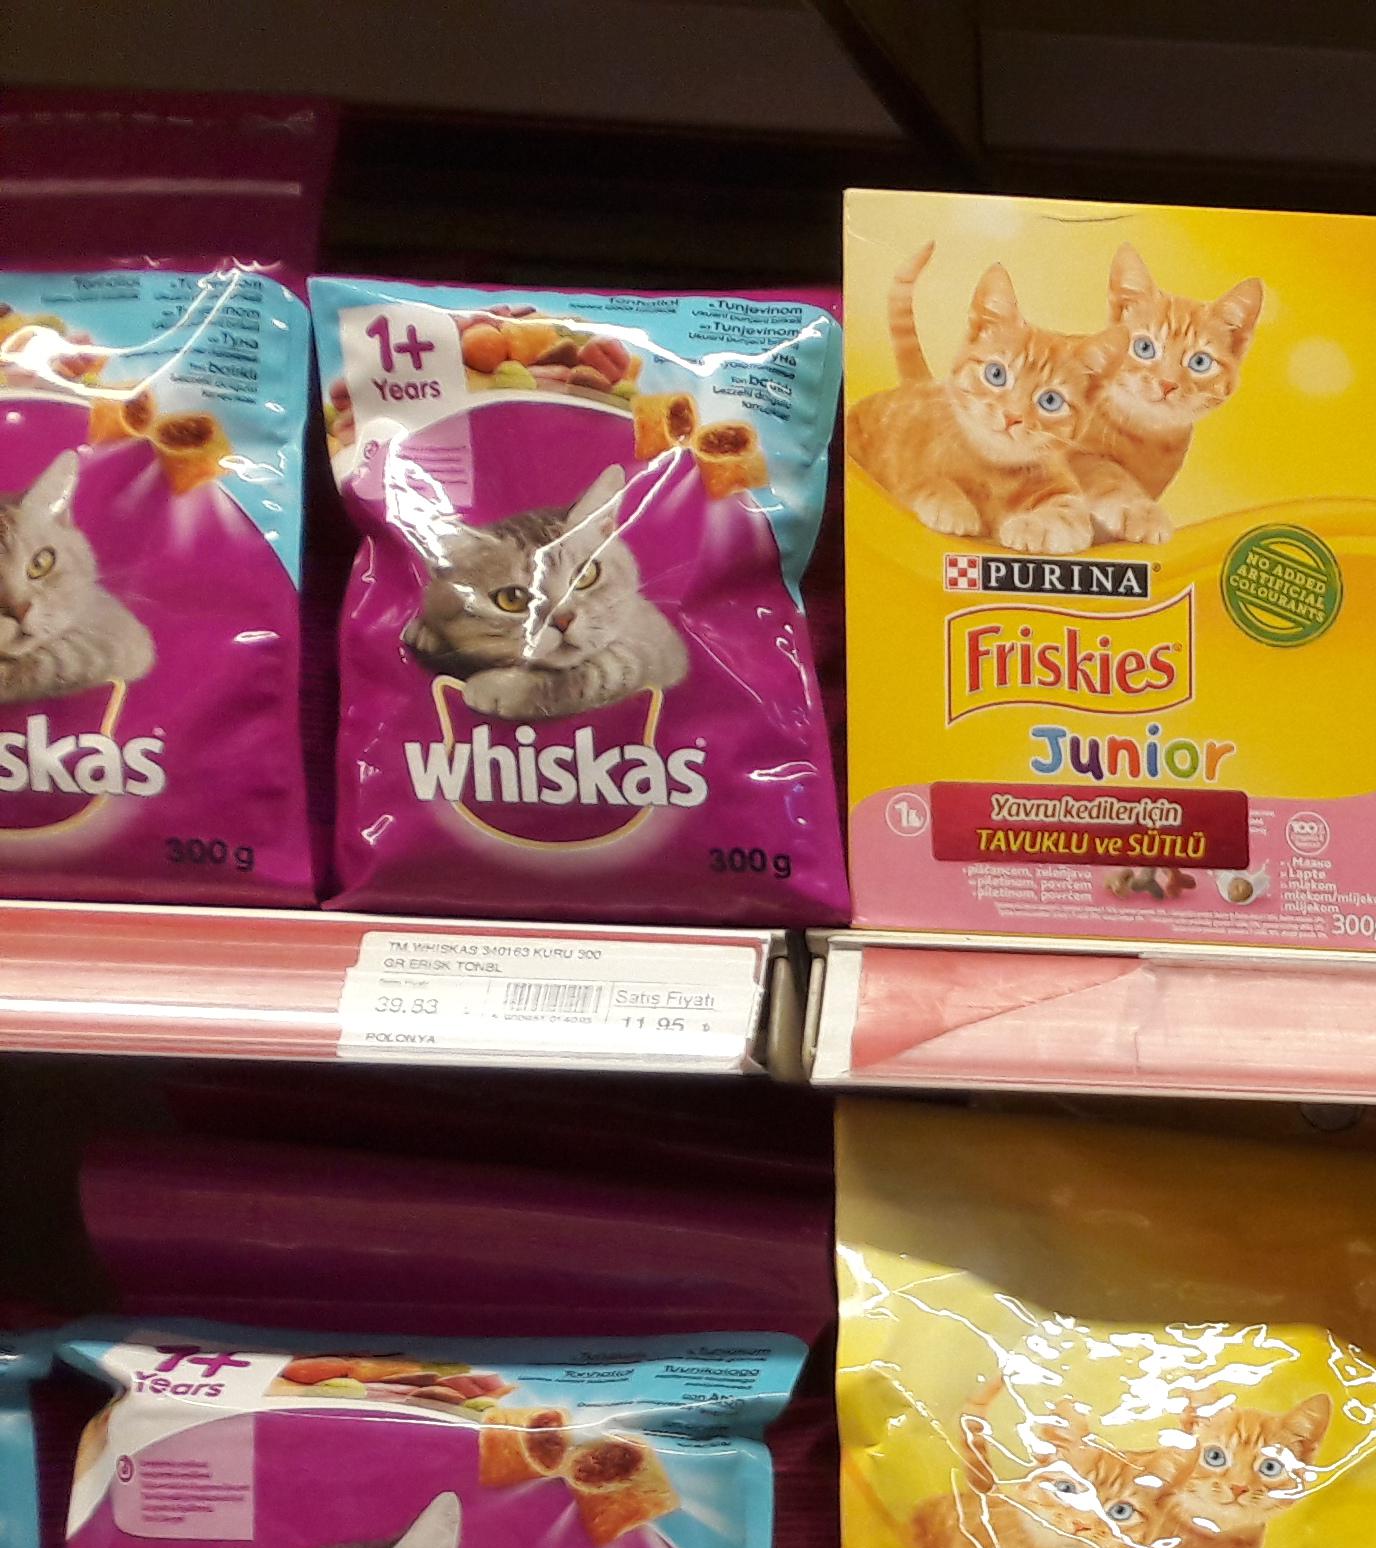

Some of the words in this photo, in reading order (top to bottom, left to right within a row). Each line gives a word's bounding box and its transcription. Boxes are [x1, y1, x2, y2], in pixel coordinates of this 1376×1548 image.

[365, 314, 435, 372] 1+
[371, 376, 442, 401] Years
[988, 562, 1142, 596] PURINA
[1237, 564, 1324, 609] ARTIFICIAL
[1246, 551, 1270, 570] NO
[1272, 564, 1326, 594] ADDED
[1229, 575, 1326, 623] COLOURANTS
[966, 622, 1178, 696] Friskies
[403, 725, 708, 808] whiskas
[1030, 723, 1237, 782] Junior
[991, 795, 1059, 823] Yavru
[1059, 798, 1138, 824] kediler
[1139, 800, 1181, 829] için
[165, 838, 226, 867] 300
[977, 828, 1088, 855] TAVUKLU
[1094, 835, 1123, 855] ve
[1126, 831, 1206, 858] SÜTLÜ
[709, 848, 769, 875] 300
[773, 852, 793, 880] g
[134, 1371, 225, 1397] Years
